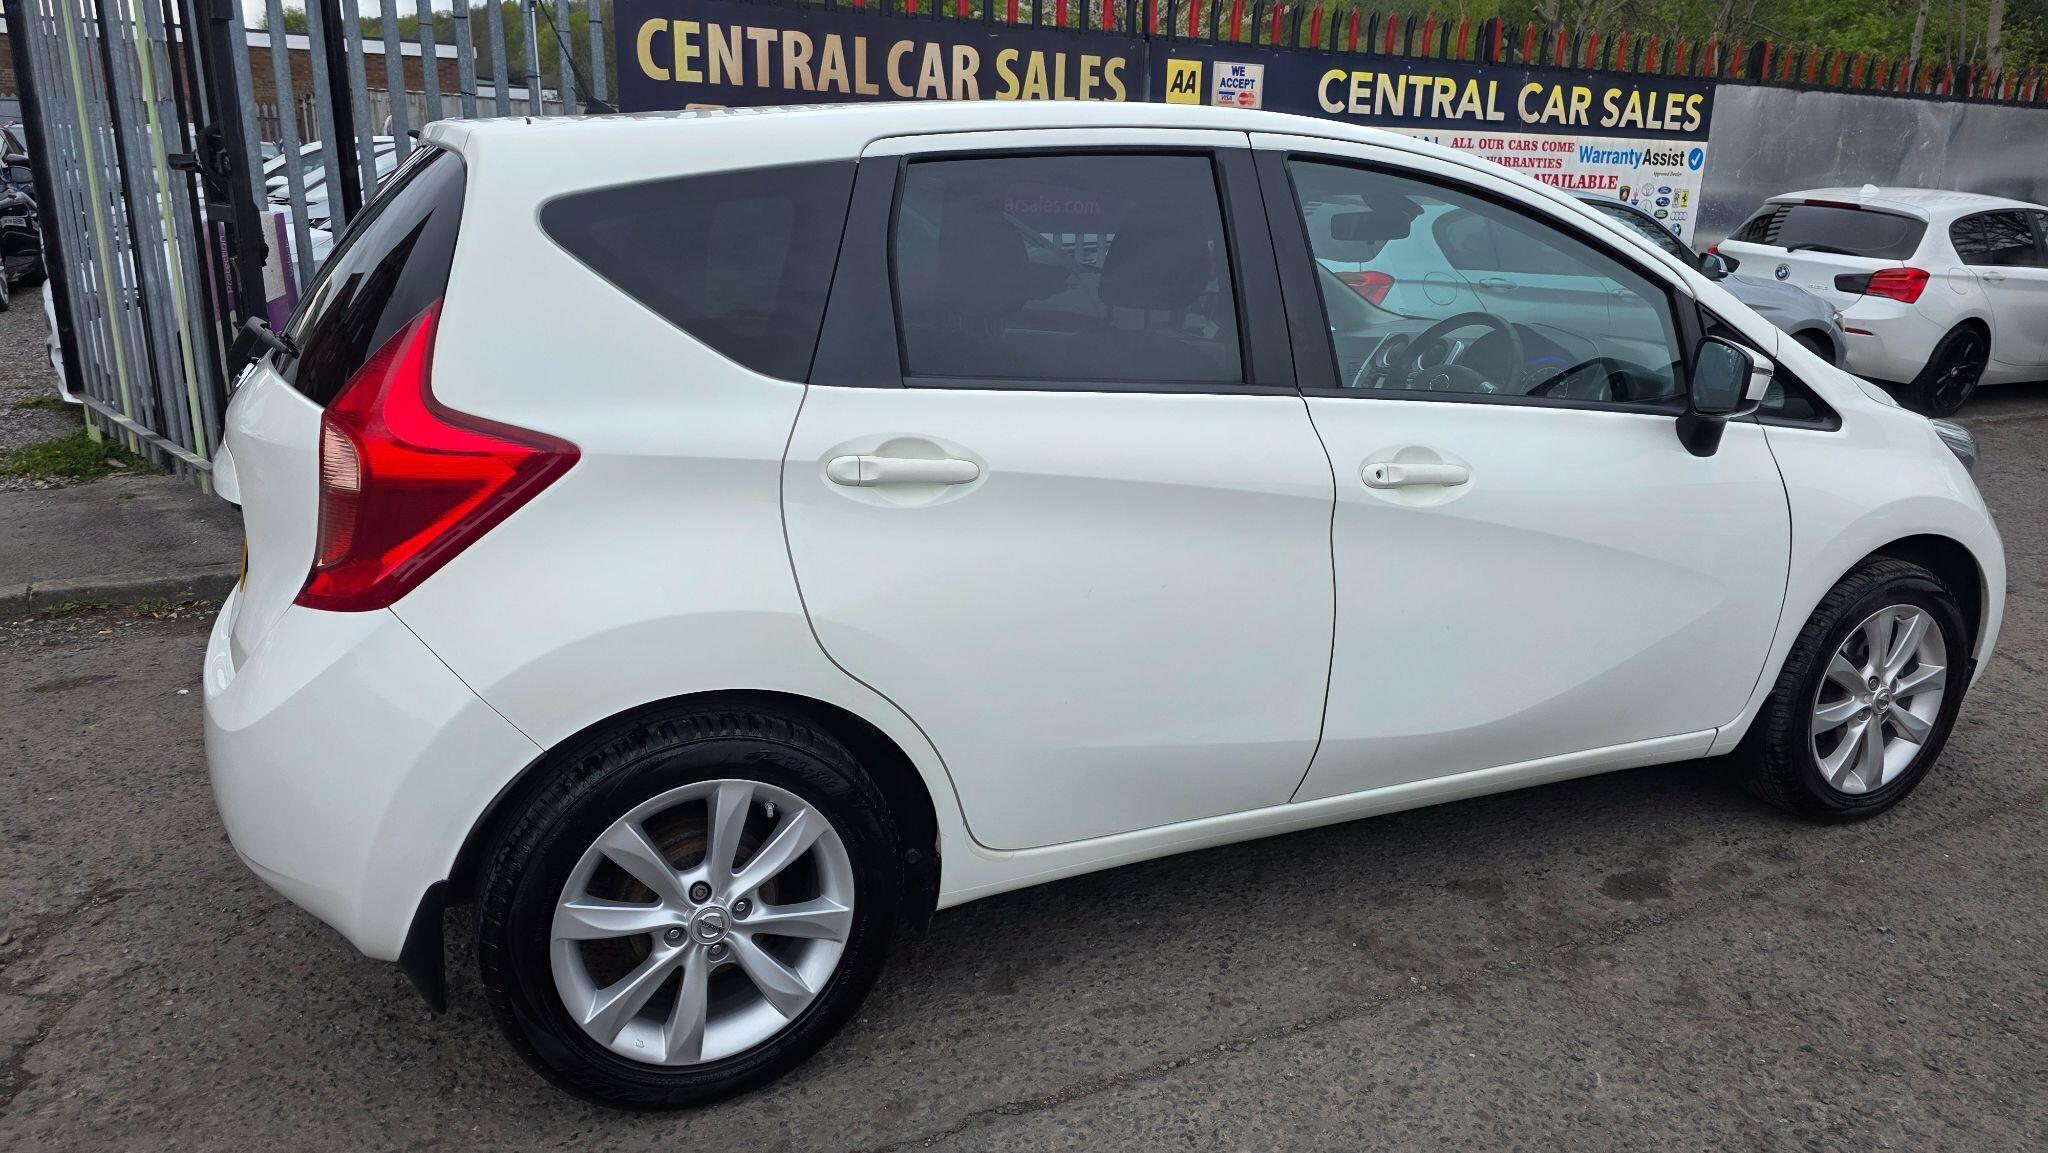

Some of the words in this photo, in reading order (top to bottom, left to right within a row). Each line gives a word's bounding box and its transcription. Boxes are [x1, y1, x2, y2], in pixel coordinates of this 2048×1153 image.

[637, 18, 879, 95] CENTRAL
[887, 39, 980, 100] CAR
[995, 48, 1127, 101] SALES
[1231, 66, 1245, 76] WE
[1170, 69, 1197, 94] AA
[1220, 77, 1255, 89] ACCEPT
[1318, 69, 1505, 121] CENTRAL
[1518, 82, 1592, 126] CAR
[1600, 87, 1704, 132] SALES
[1450, 137, 1474, 149] ALL
[1478, 138, 1504, 150] OUR
[1508, 140, 1538, 151] CARS
[1542, 141, 1575, 153] COME
[1487, 155, 1562, 169] WARRANTIES
